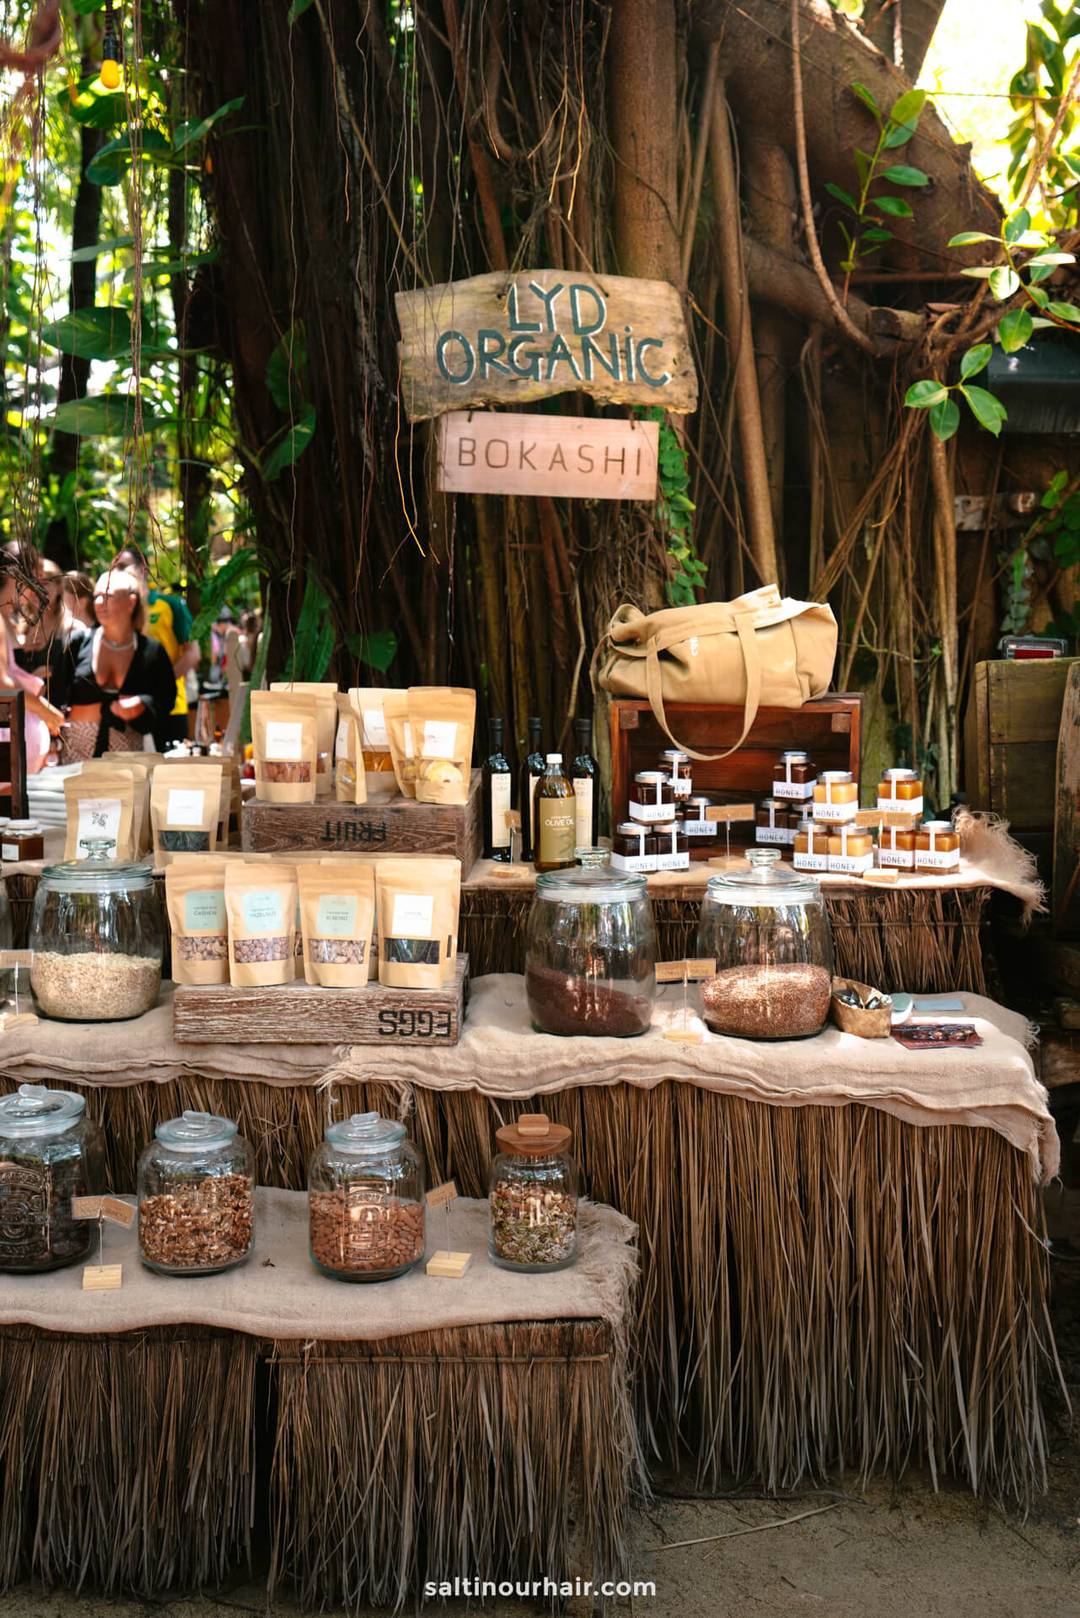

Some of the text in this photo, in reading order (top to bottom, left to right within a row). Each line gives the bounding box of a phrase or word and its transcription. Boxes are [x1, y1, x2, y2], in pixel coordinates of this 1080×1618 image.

[508, 280, 608, 336] LYD
[458, 436, 642, 476] BOKASHI
[775, 788, 800, 797] HONEY
[815, 809, 841, 818] HONEY
[320, 821, 387, 842] FRUIT
[688, 825, 714, 834] HONEY
[758, 833, 785, 842] HONEY
[796, 859, 823, 868] HONEY
[881, 855, 907, 865] HONEY
[917, 856, 943, 866] HONEY
[830, 861, 856, 871] HONEY
[378, 1011, 452, 1038] EGGS
